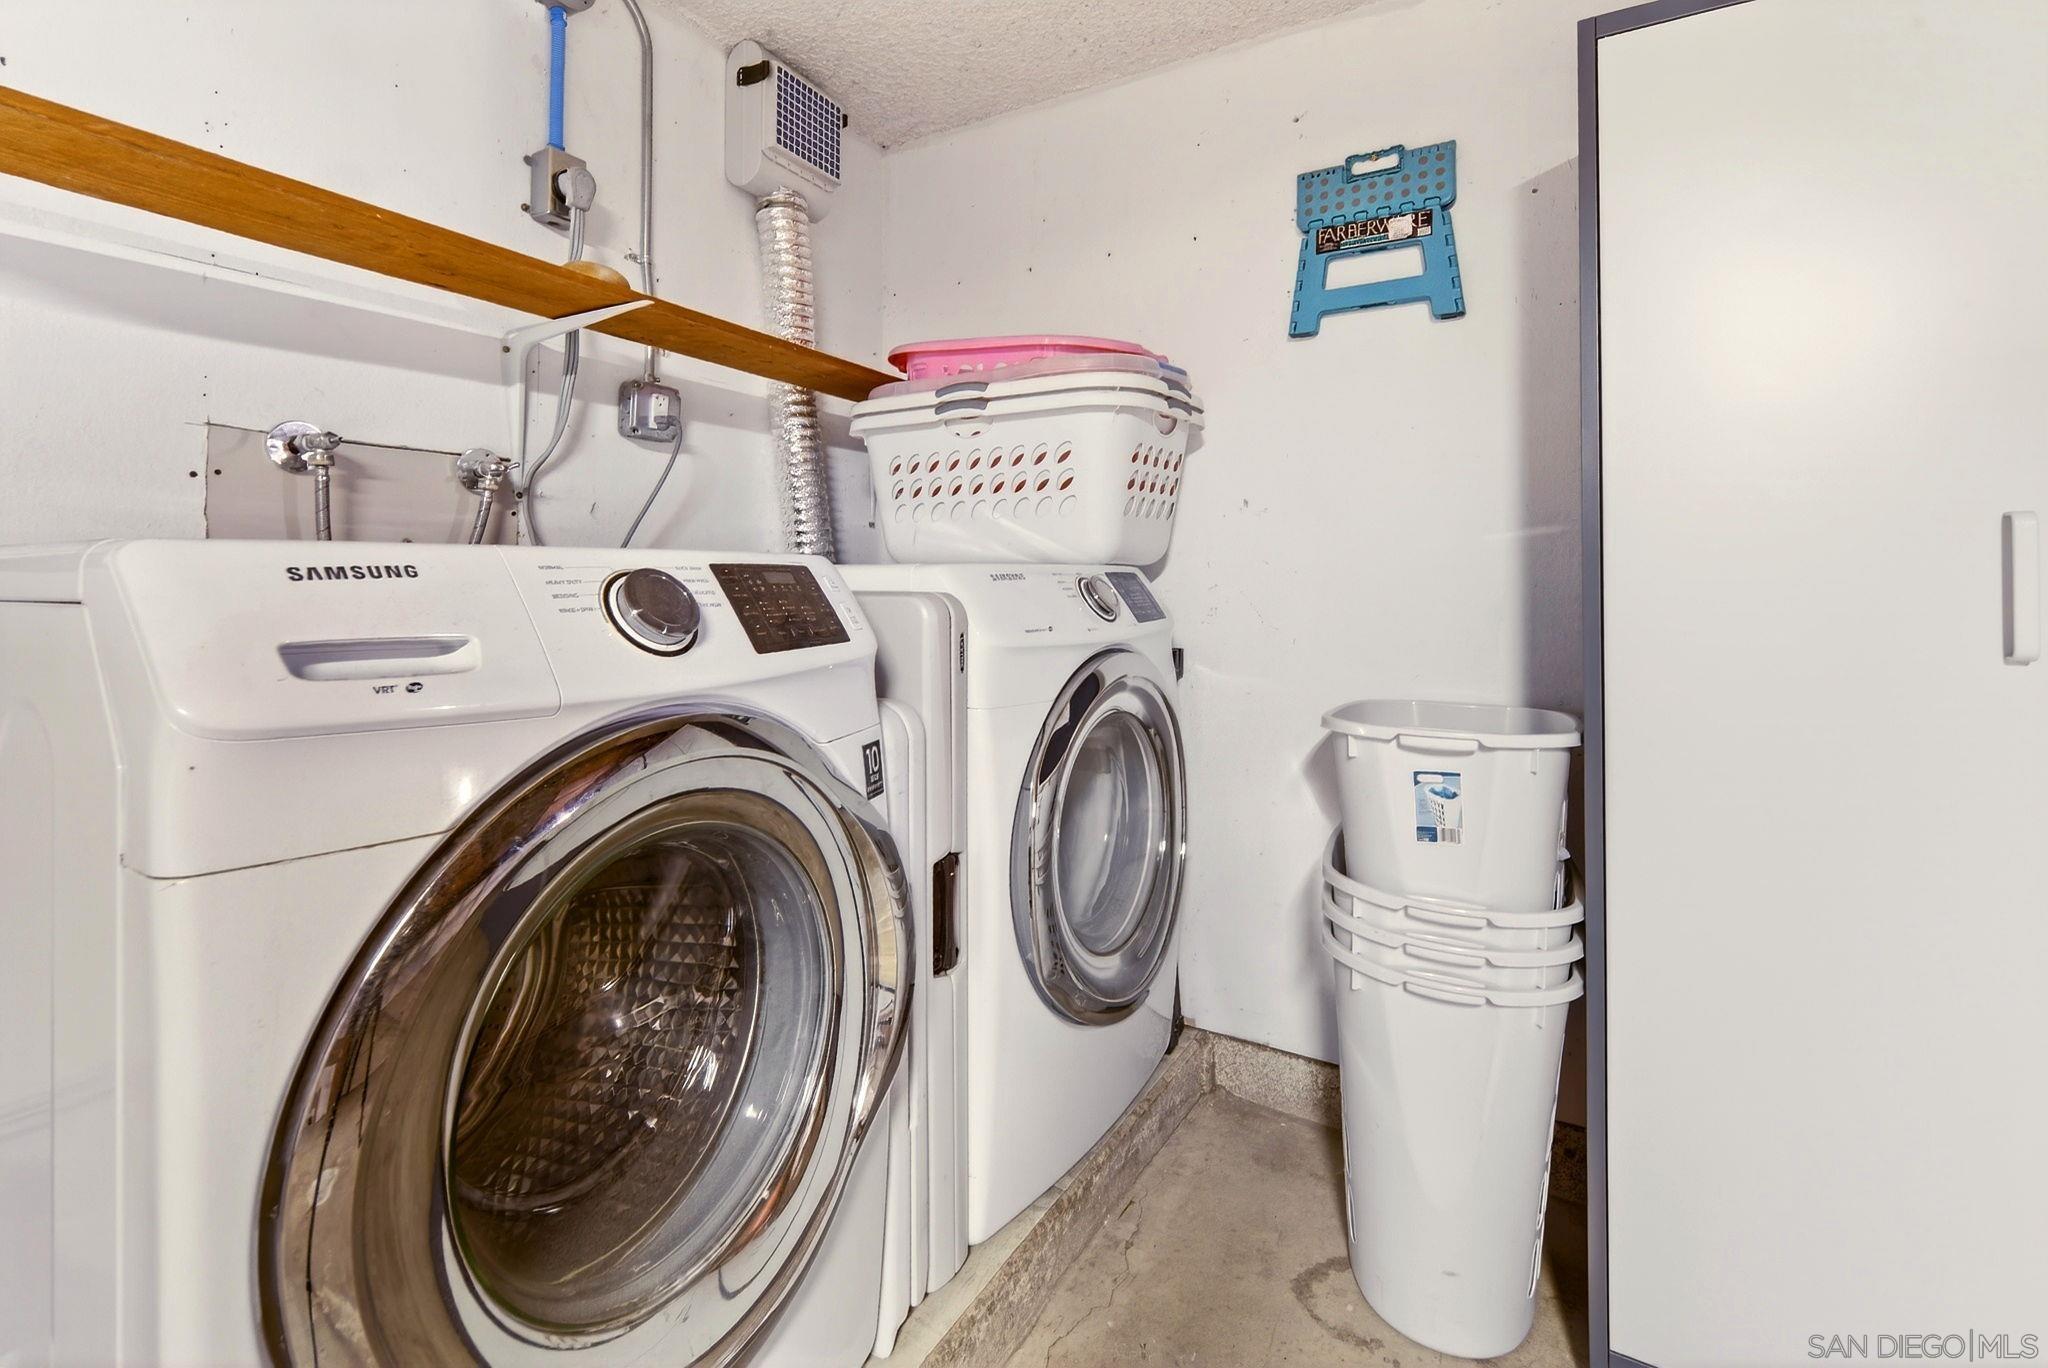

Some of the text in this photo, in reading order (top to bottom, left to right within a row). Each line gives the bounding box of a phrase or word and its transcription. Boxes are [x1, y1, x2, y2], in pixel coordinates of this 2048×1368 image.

[1318, 211, 1430, 245] FARBERWRE
[286, 564, 419, 581] SAMSUNG
[866, 745, 879, 774] 10
